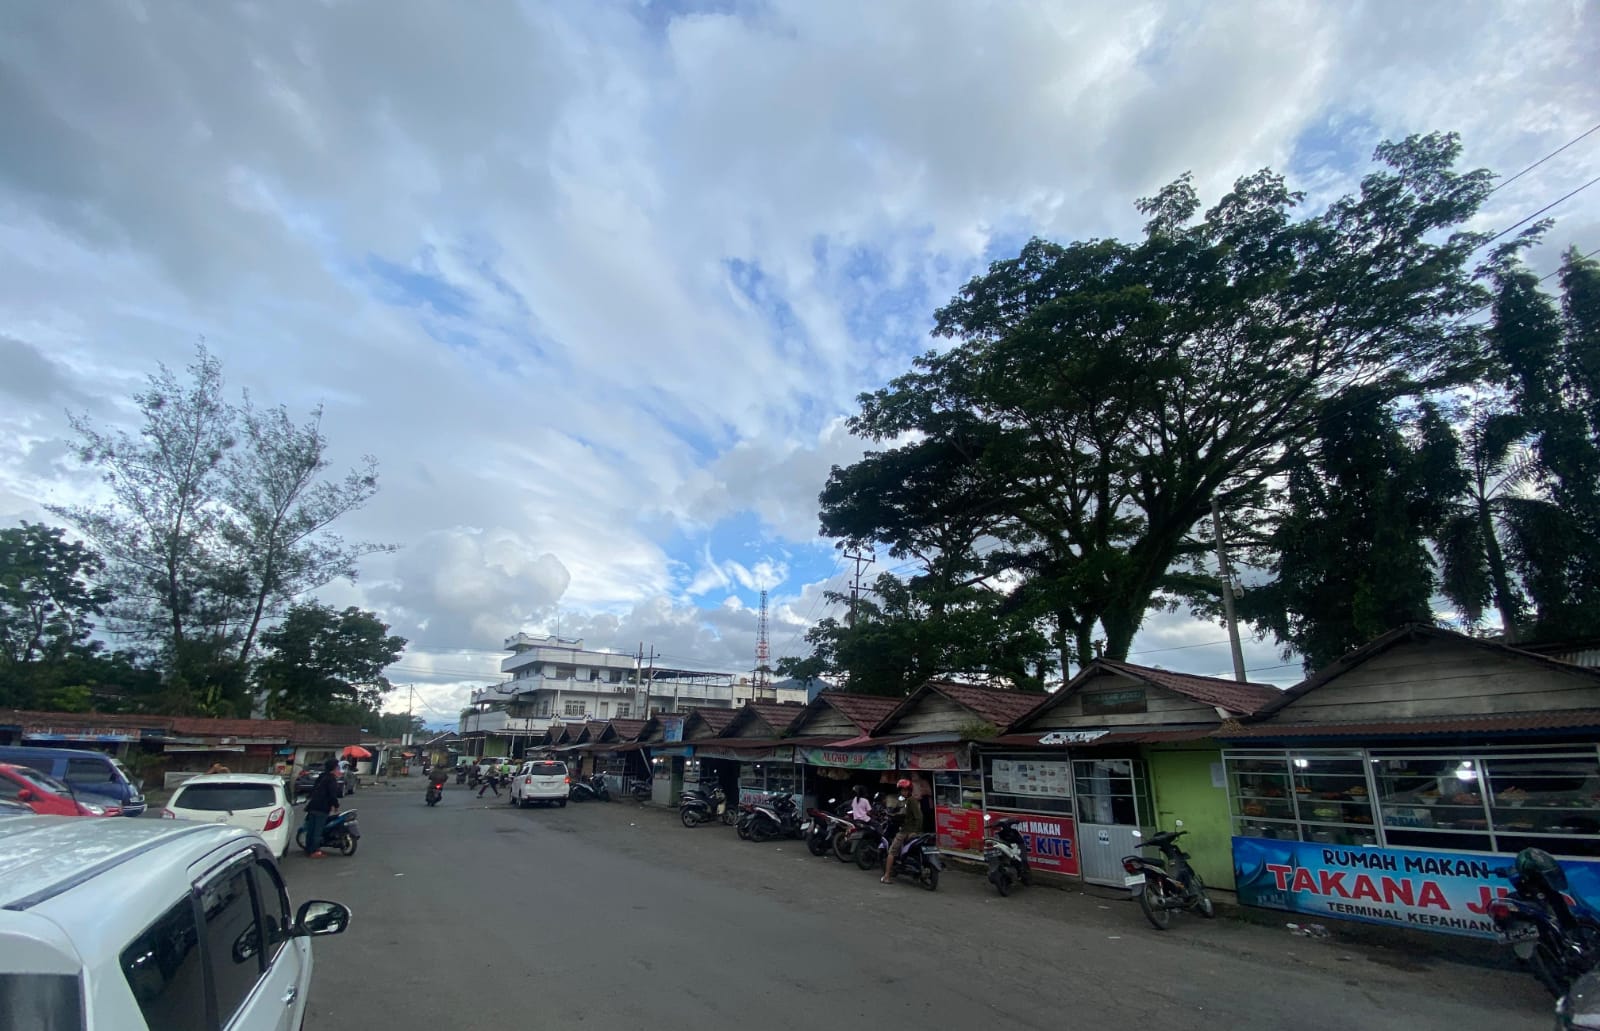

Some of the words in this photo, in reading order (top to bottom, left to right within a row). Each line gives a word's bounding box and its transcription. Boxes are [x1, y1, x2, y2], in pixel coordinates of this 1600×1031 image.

[1029, 821, 1061, 836] MAKAN
[1036, 836, 1072, 858] KITE
[1322, 849, 1397, 871] RUMAH
[1403, 856, 1489, 879] MAKAN
[1266, 864, 1451, 910] TAKANA
[1326, 902, 1403, 921] TERMINAL
